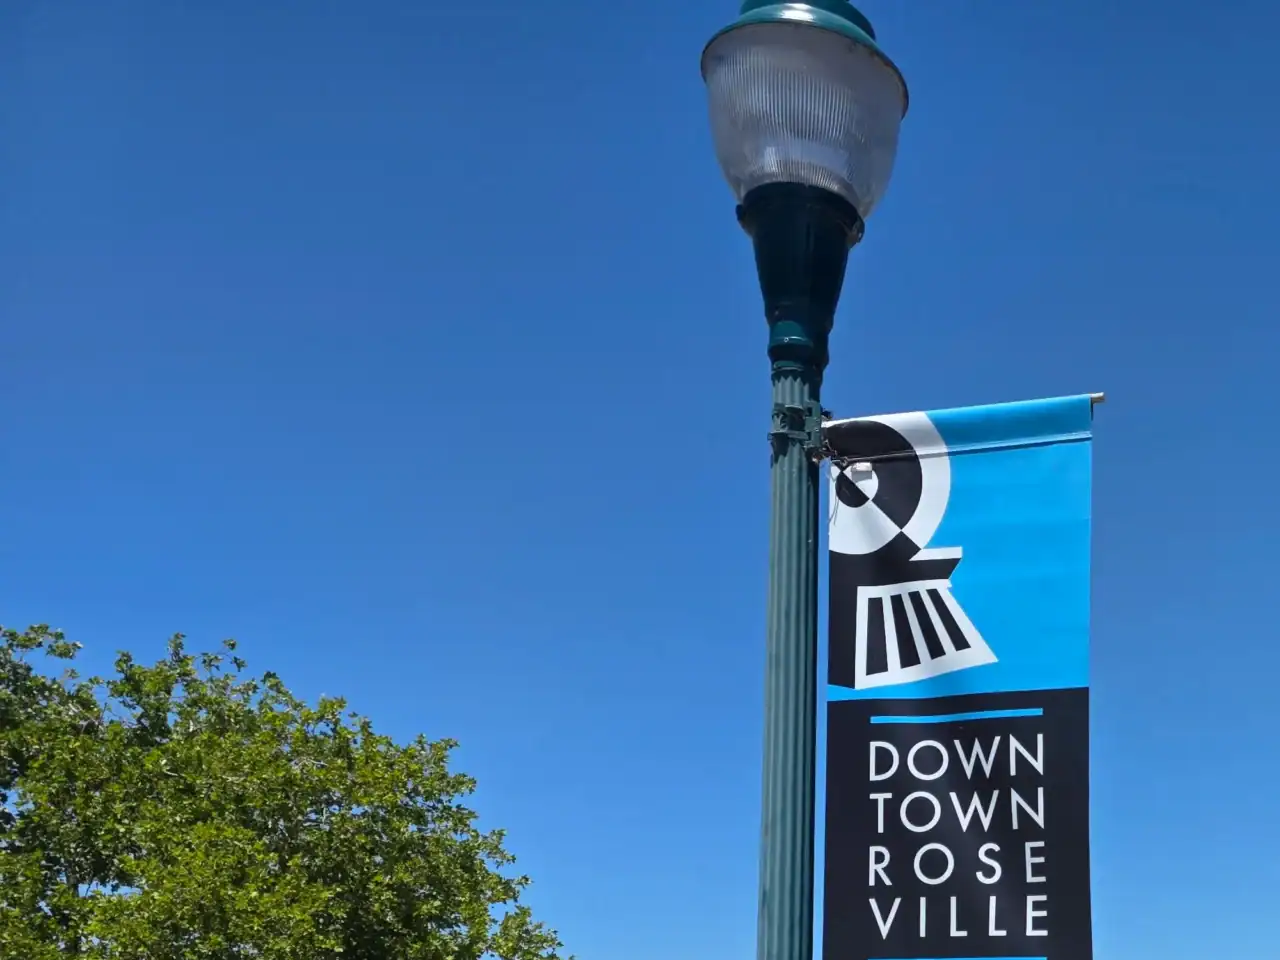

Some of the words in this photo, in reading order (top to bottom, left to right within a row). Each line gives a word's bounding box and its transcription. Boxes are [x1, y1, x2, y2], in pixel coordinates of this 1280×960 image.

[869, 733, 1044, 781] DOWN
[869, 787, 1045, 833] TOWN
[868, 841, 1047, 886] ROSE
[869, 895, 1048, 940] VILLE
